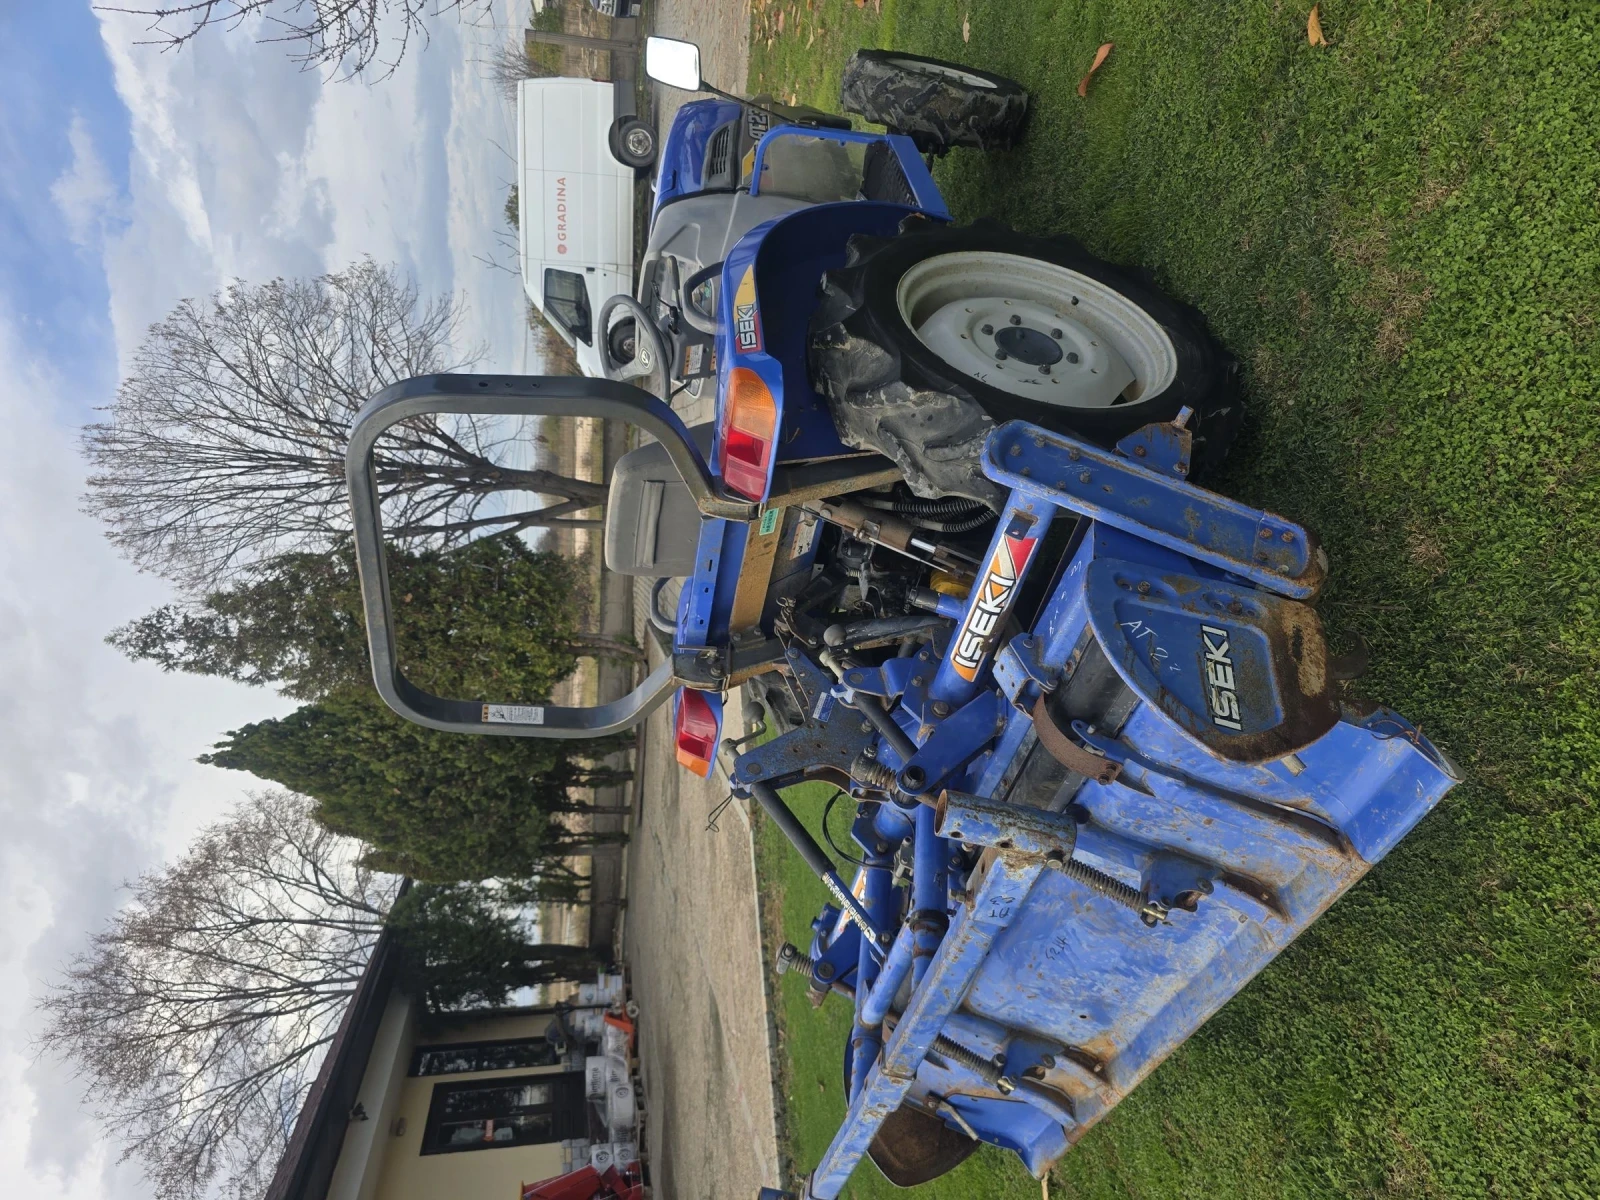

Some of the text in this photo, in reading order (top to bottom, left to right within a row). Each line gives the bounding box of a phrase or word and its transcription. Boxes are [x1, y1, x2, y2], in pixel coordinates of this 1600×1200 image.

[556, 177, 567, 241] GRADINA
[737, 304, 757, 350] ISEKI
[953, 571, 1016, 669] ISEKI
[1201, 623, 1242, 731] ISEKI
